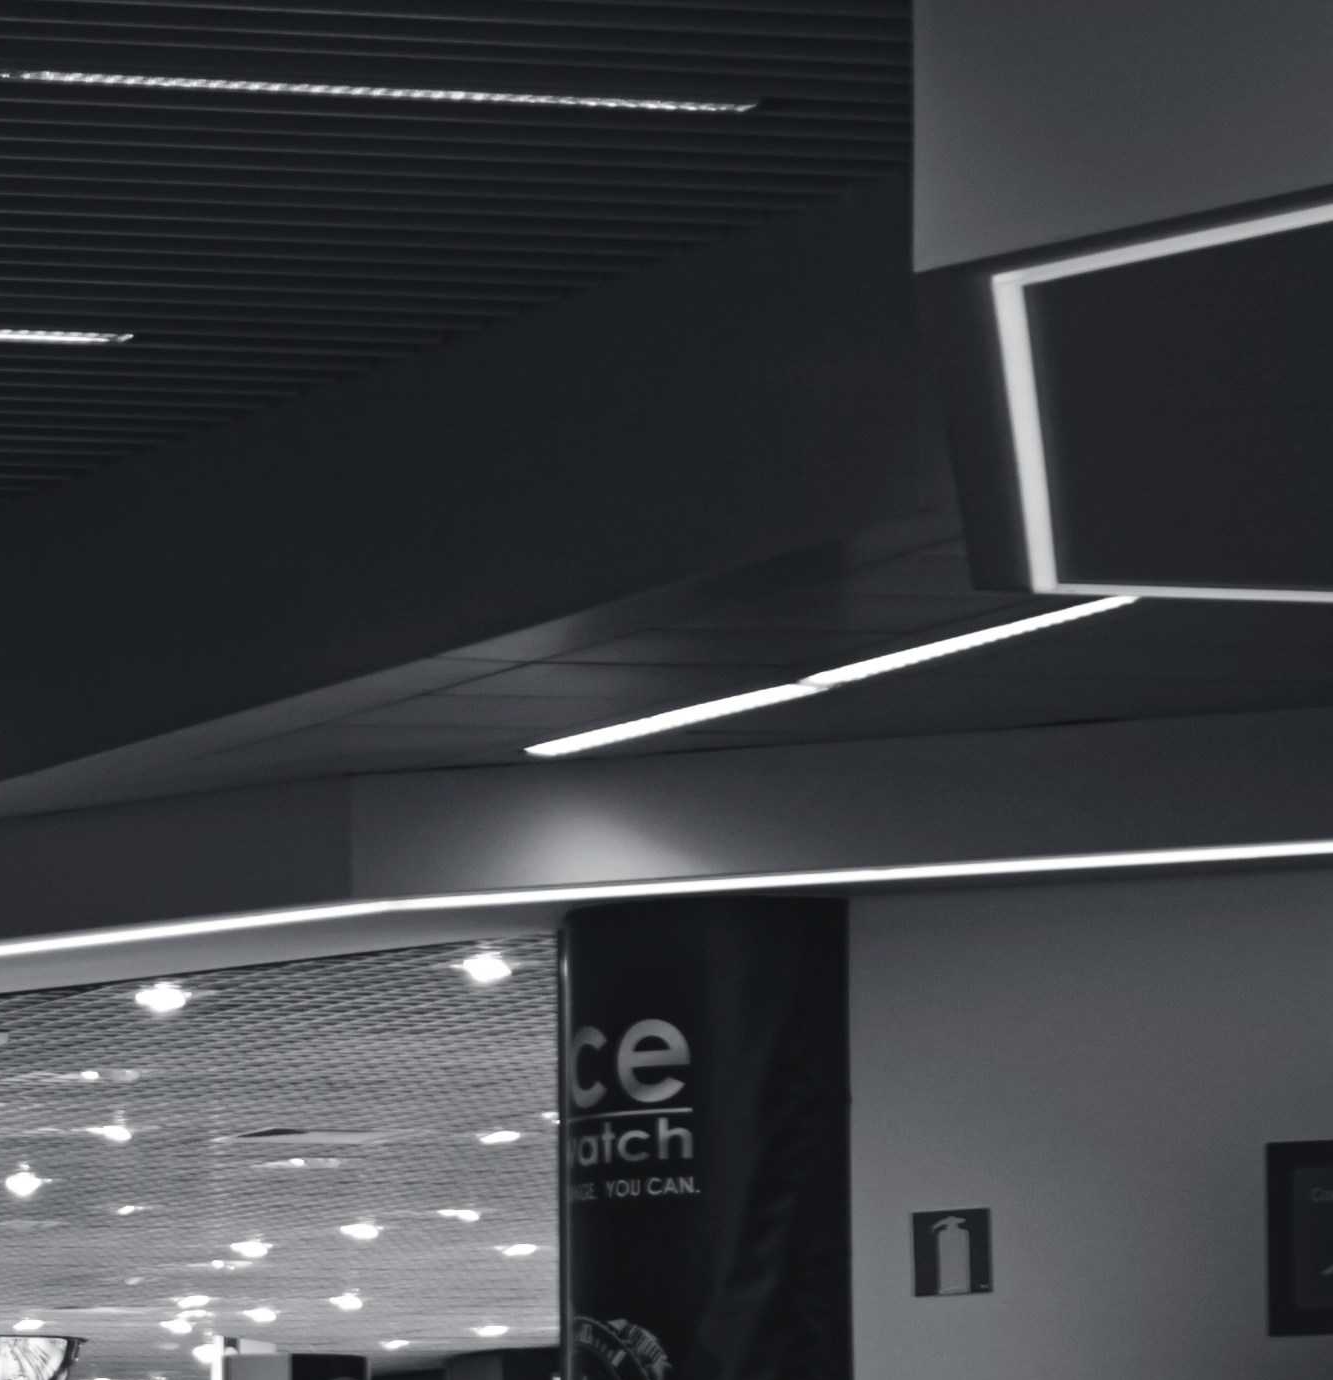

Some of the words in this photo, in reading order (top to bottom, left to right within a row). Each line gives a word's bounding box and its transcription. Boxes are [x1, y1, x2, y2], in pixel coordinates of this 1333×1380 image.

[572, 1117, 694, 1167] atch
[605, 1179, 641, 1198] YOU
[646, 1176, 702, 1196] CAN.
